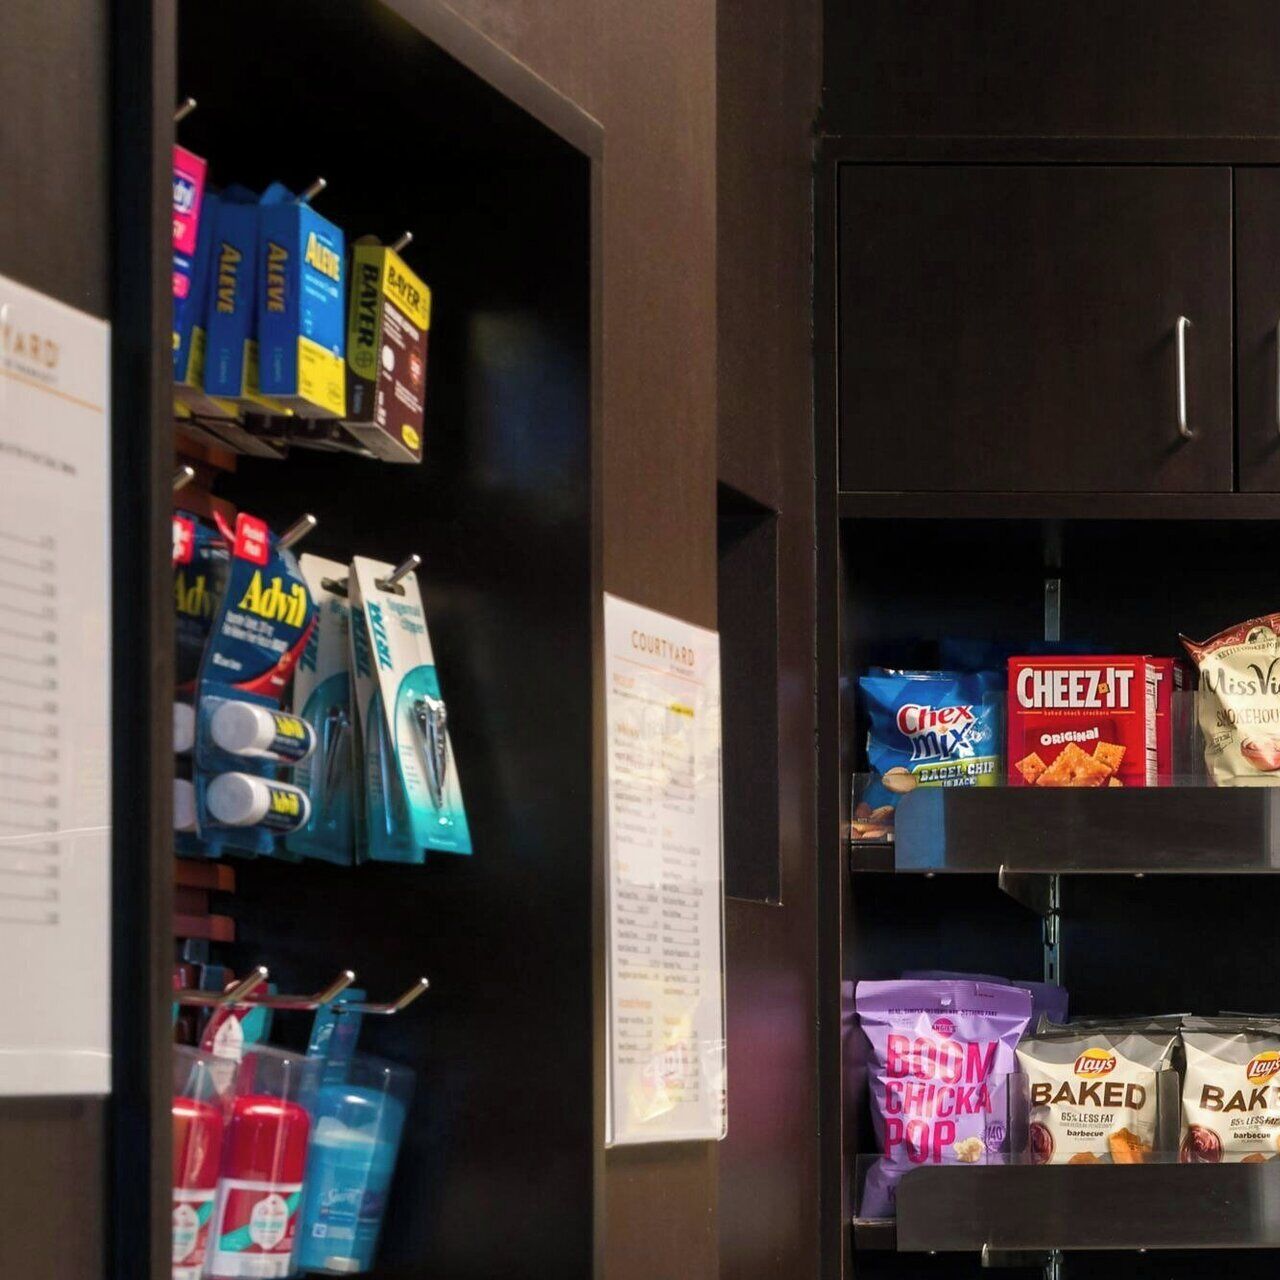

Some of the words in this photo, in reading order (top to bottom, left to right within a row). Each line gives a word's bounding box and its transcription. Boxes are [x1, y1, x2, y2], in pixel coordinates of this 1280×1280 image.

[386, 264, 422, 308] BAYER
[360, 263, 380, 348] BAYER
[237, 569, 308, 629] Advil
[632, 630, 695, 667] COURTYARD
[898, 704, 973, 735] Chex
[887, 1034, 998, 1084] BOOM
[885, 1079, 993, 1119] CHICKA
[1031, 1081, 1147, 1111] BAKED
[1067, 1129, 1104, 1137] barbecue
[1079, 1112, 1099, 1123] LESS
[1100, 1113, 1114, 1123] FAT
[1233, 1131, 1271, 1139] barbecue
[1246, 1116, 1264, 1126] LESS
[884, 1117, 956, 1164] POP
